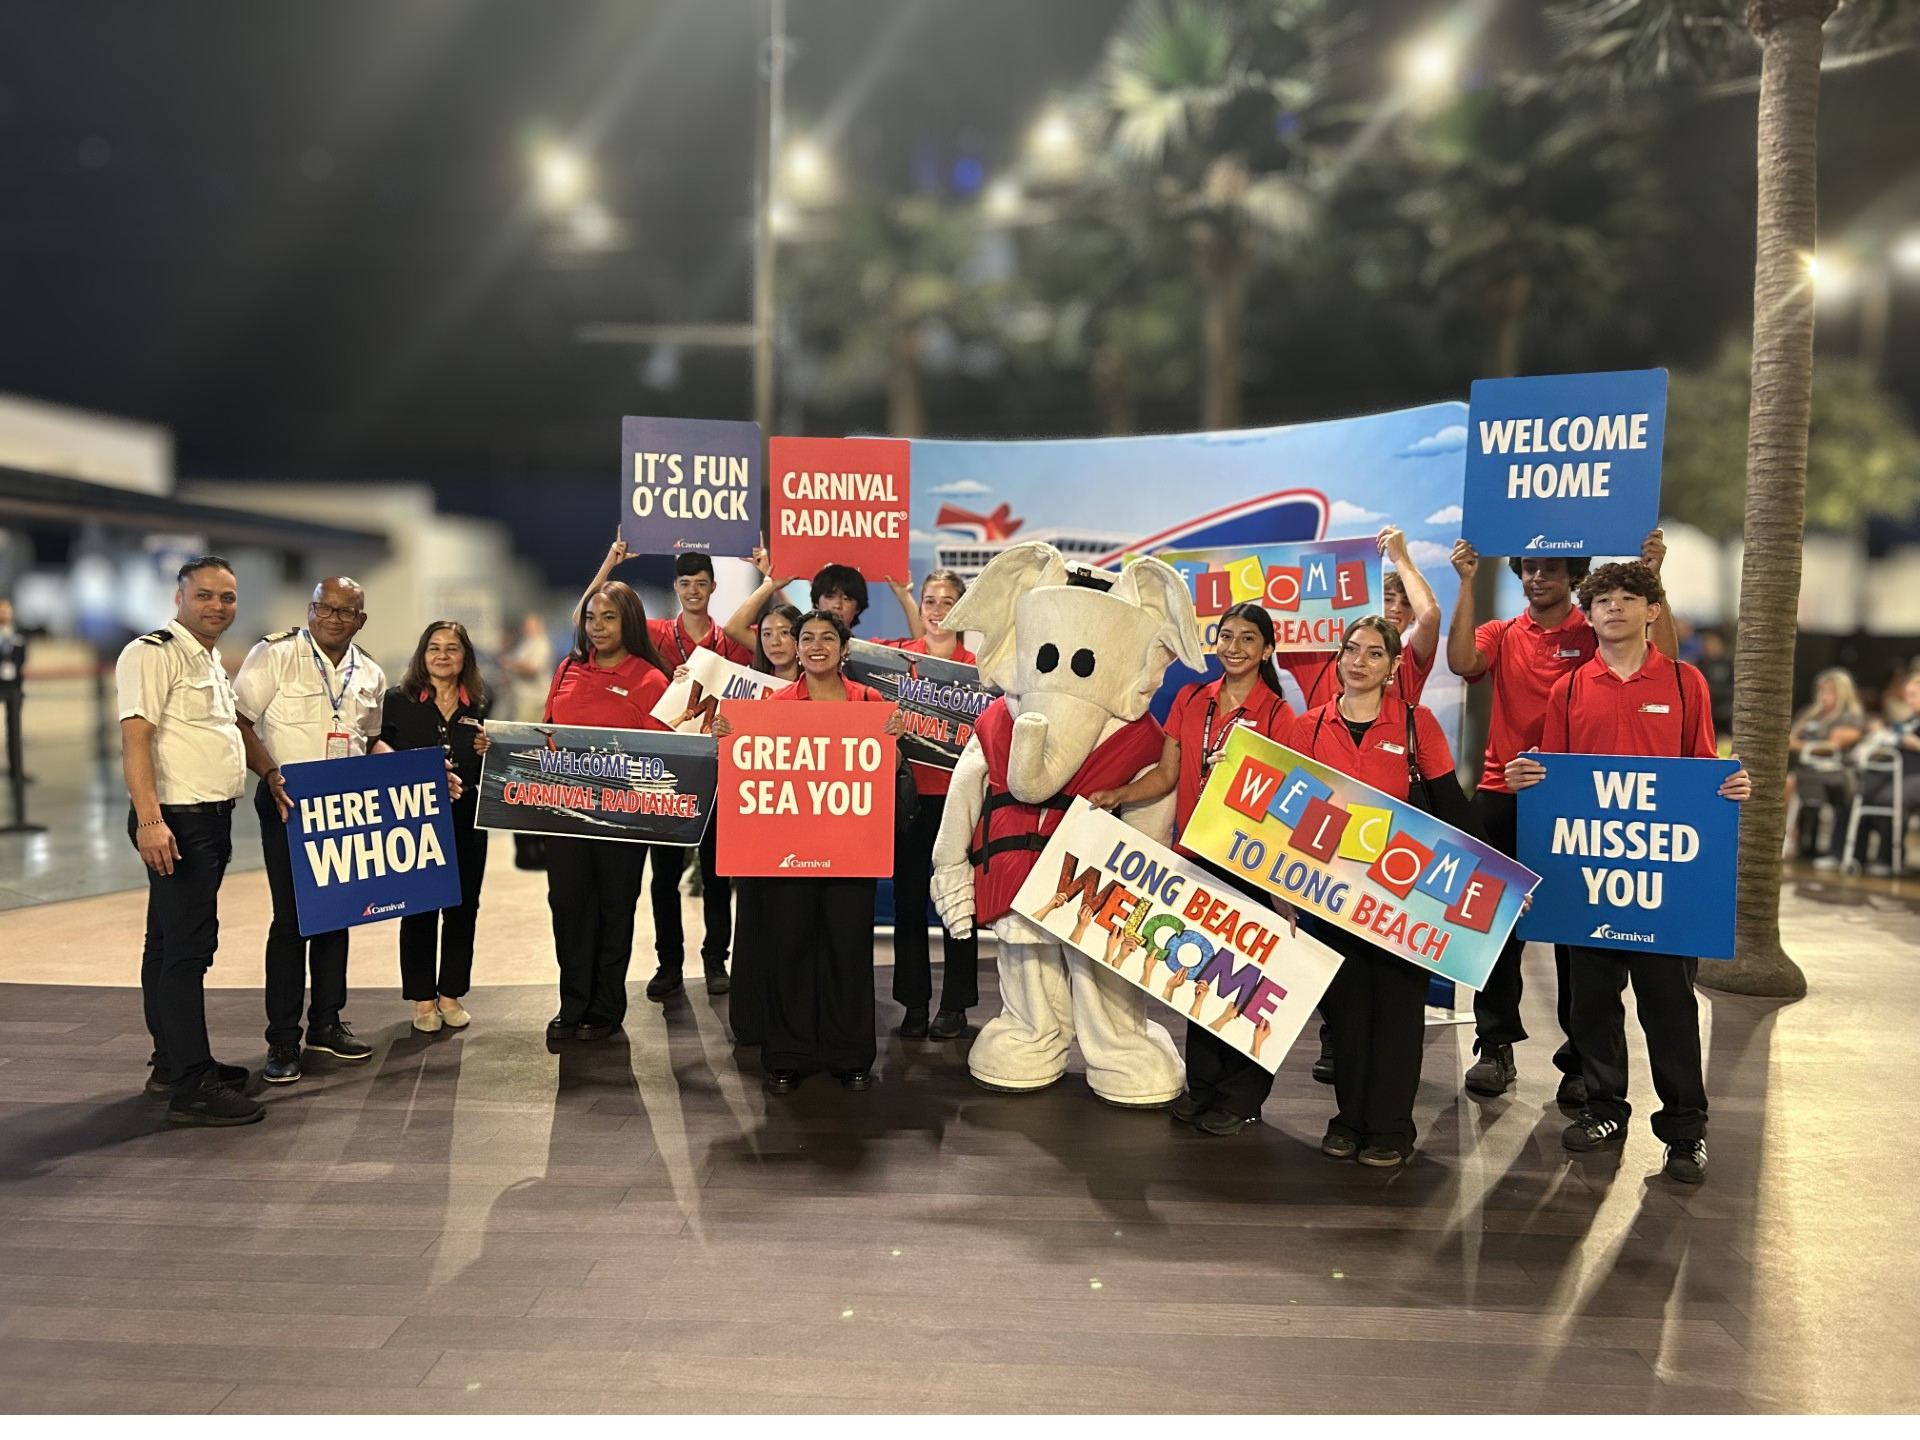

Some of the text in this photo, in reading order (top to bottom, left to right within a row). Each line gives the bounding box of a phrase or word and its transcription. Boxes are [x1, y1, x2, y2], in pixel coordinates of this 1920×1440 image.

[1479, 413, 1649, 455] WELCOME
[634, 453, 748, 487] IT'S FUN
[782, 472, 898, 501] CARNIVAL
[1507, 461, 1610, 499] HOME
[632, 486, 749, 521] O'CLOCK
[1539, 538, 1584, 550] Carnival
[1180, 561, 1353, 608] LCOME
[722, 674, 757, 700] LONG
[539, 750, 664, 781] WELCOME TO
[732, 736, 881, 772] GREAT TO
[300, 782, 440, 833] HERE WE
[504, 782, 697, 819] CARNIVAL RADIANCE
[739, 780, 872, 816] SEA YOU
[1592, 771, 1657, 811] WE
[304, 823, 446, 887] WHOA
[1240, 768, 1485, 920] WELCOME
[1552, 818, 1699, 862] MISSED
[790, 859, 831, 869] Carnival
[1105, 841, 1279, 965] LONG BEACH
[1227, 830, 1450, 962] TO LONG BEACH
[1581, 867, 1663, 910] YOU
[1056, 851, 1287, 1025] WELCOME
[1604, 929, 1655, 943] Carnival
